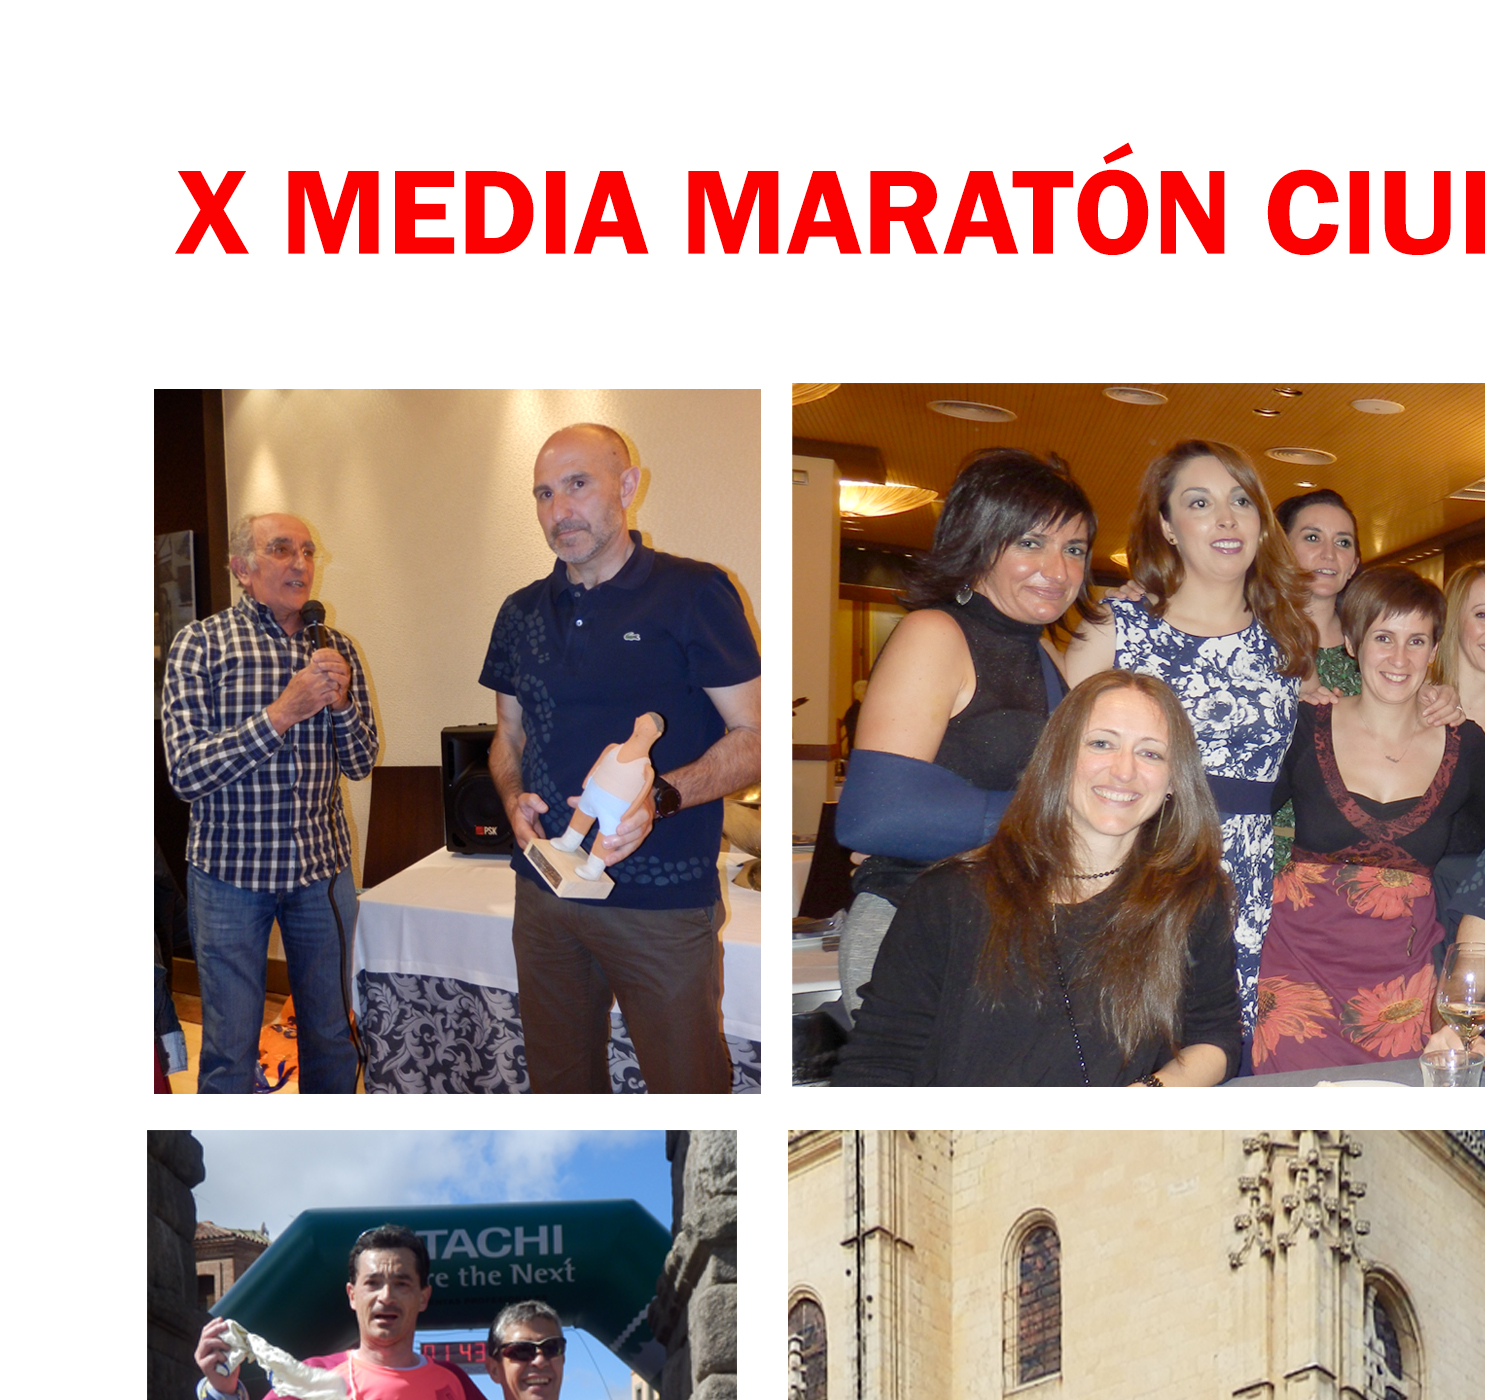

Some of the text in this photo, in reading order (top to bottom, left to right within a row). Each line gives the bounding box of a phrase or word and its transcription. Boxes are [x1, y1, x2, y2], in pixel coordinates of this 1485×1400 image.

[415, 1224, 563, 1260] TACHI
[458, 1265, 502, 1287] the
[509, 1257, 576, 1285] Next
